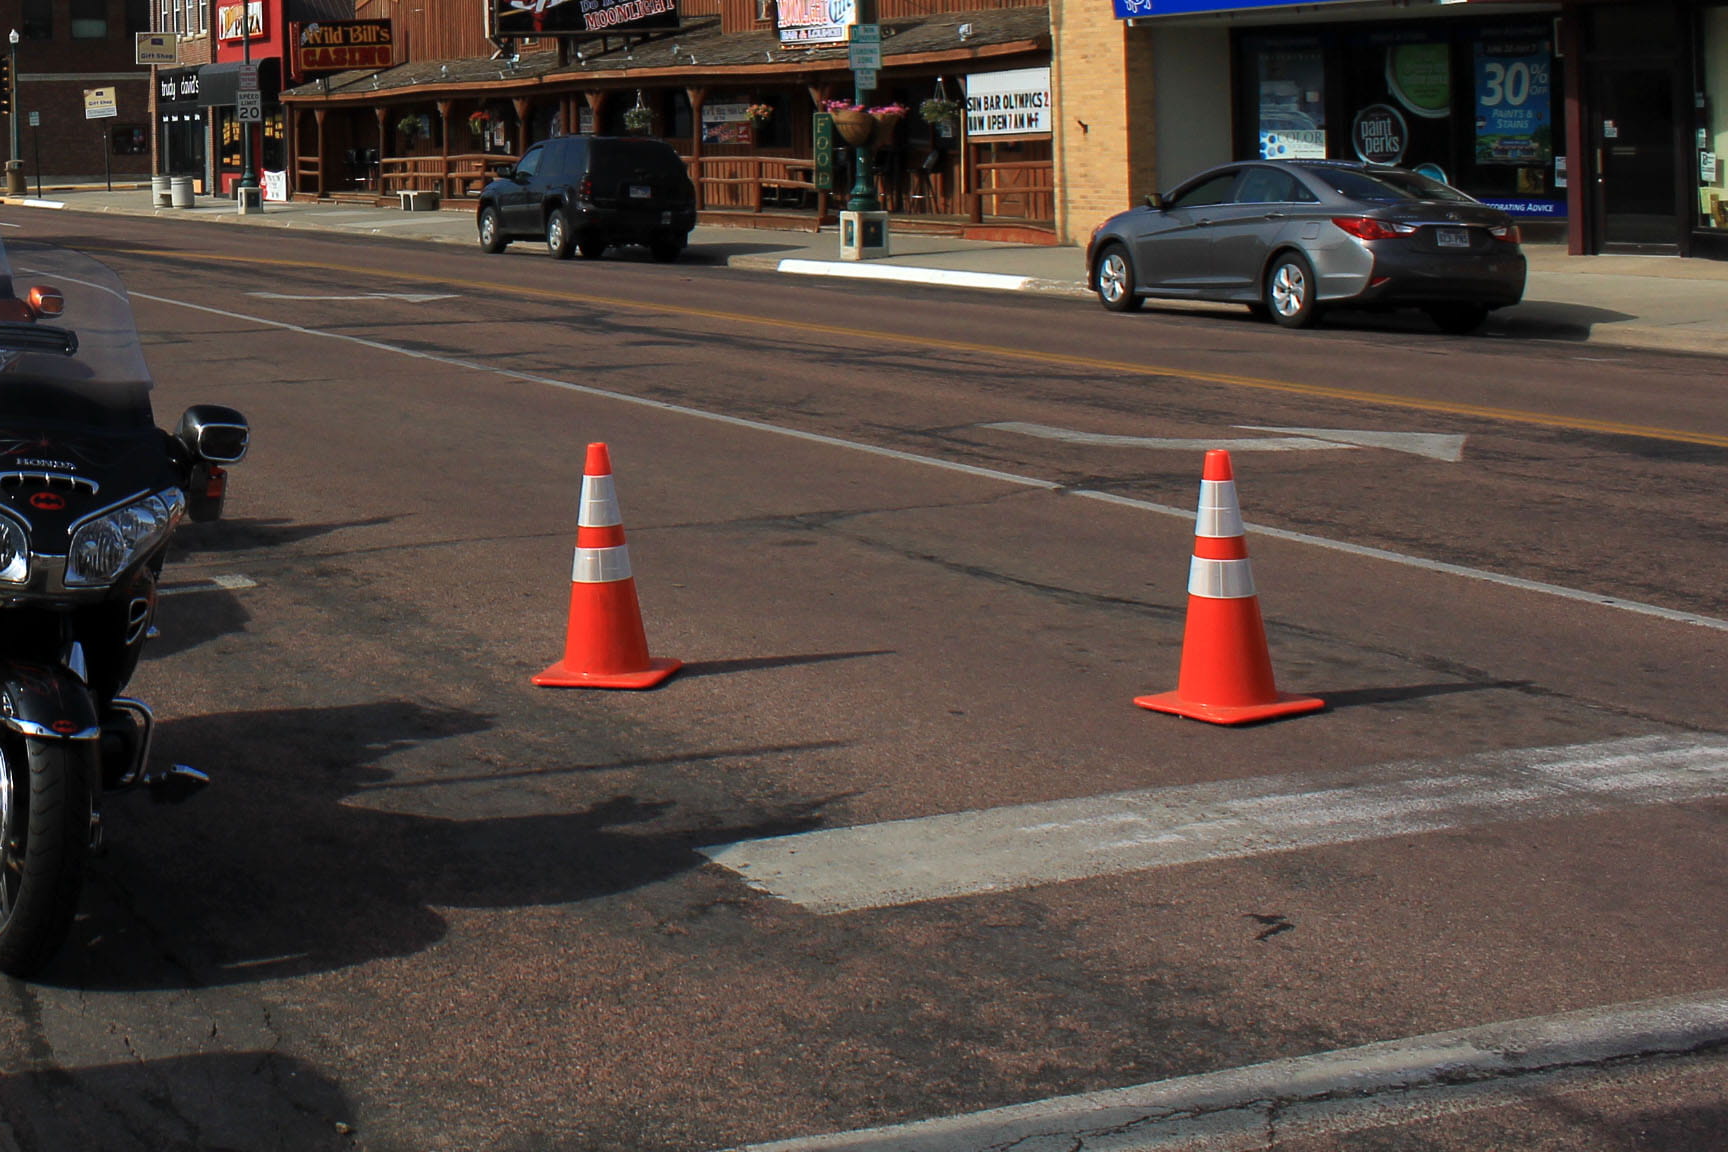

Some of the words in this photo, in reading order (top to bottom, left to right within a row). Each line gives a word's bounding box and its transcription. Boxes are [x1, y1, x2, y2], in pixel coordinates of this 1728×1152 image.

[580, 0, 599, 12] Do
[234, 14, 261, 37] PIZA
[305, 25, 342, 44] Wild
[344, 24, 390, 43] Bill's
[303, 46, 391, 67] CASINO
[983, 95, 1001, 110] BAR
[1003, 92, 1042, 109] OLYMPICS
[239, 107, 260, 119] 20
[987, 114, 1007, 130] OPEN
[1361, 117, 1392, 139] paint
[1277, 131, 1322, 144] COLOR
[1364, 134, 1400, 155] perks
[817, 117, 830, 186] FOOD
[1526, 203, 1554, 212] ADVICE
[16, 457, 78, 470] HONDA
